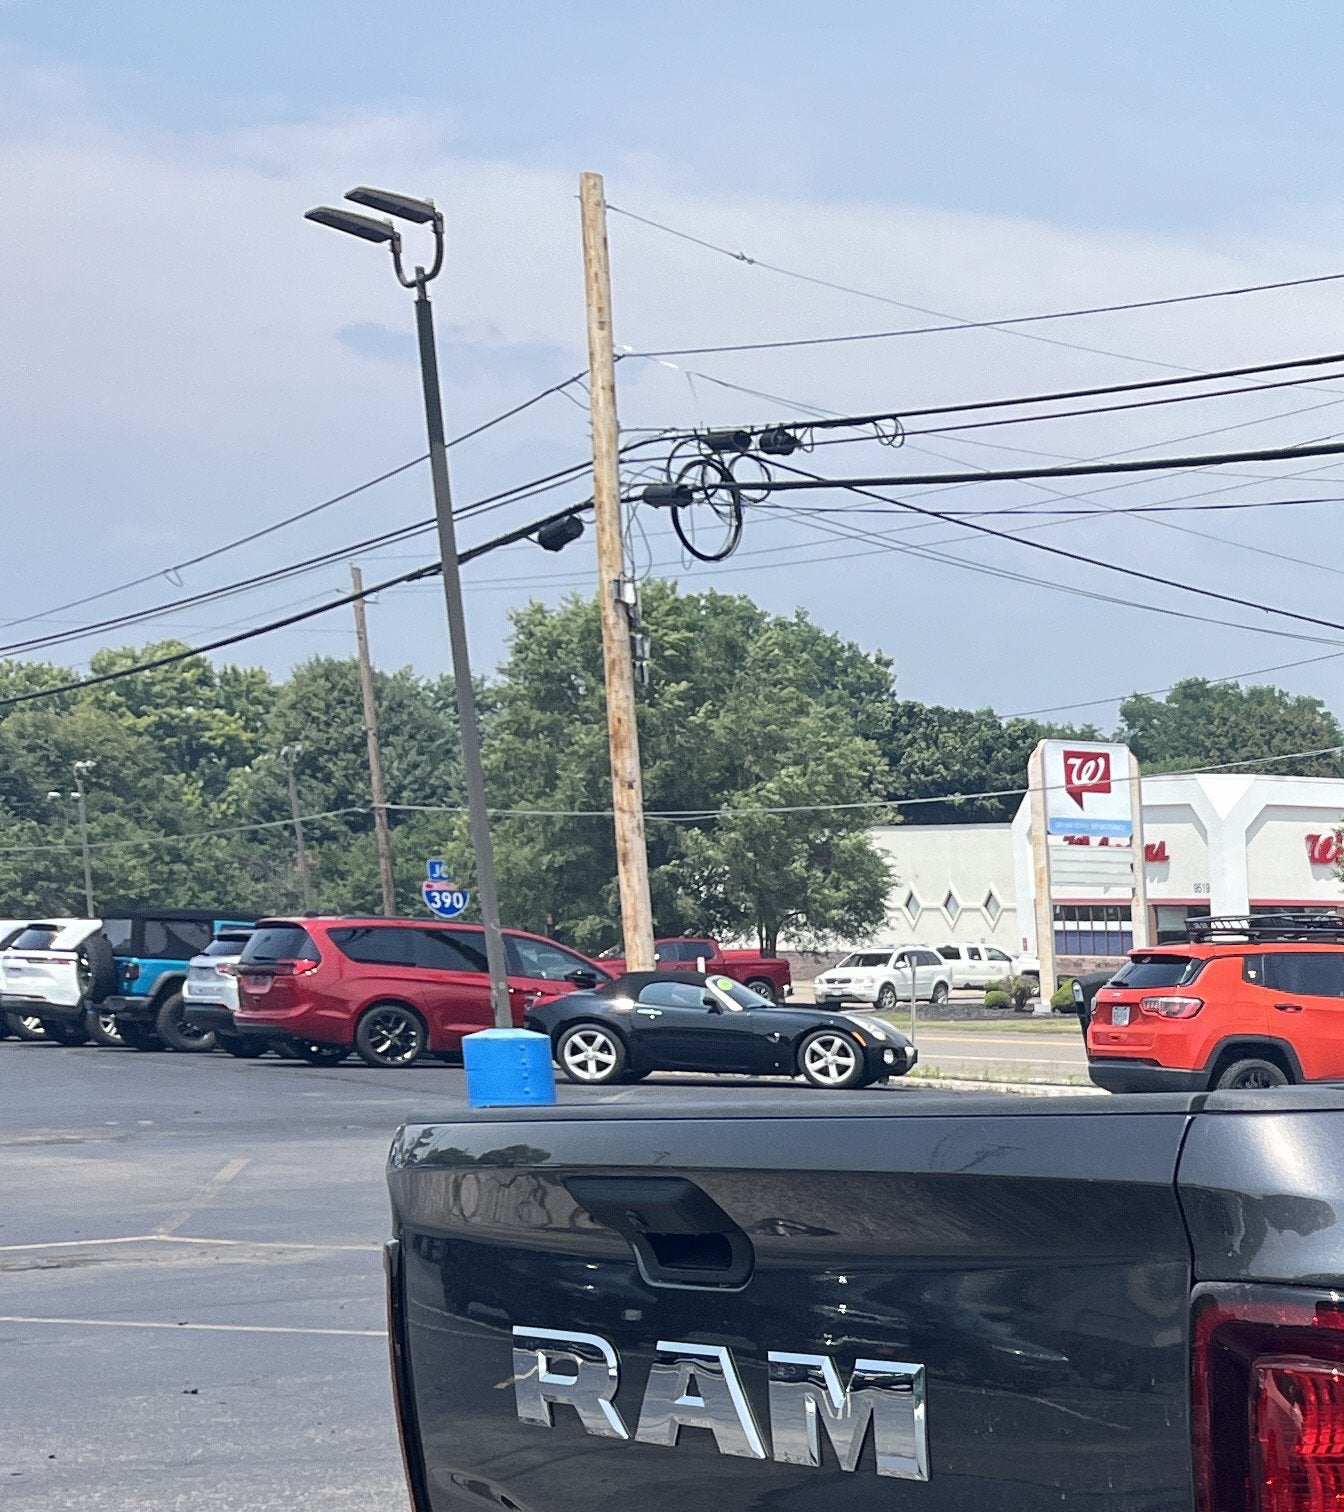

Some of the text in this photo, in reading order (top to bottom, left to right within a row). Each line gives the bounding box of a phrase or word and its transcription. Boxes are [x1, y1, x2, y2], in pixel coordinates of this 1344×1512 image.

[1067, 757, 1106, 786] W
[431, 891, 464, 909] 390
[512, 1325, 930, 1482] RAM
